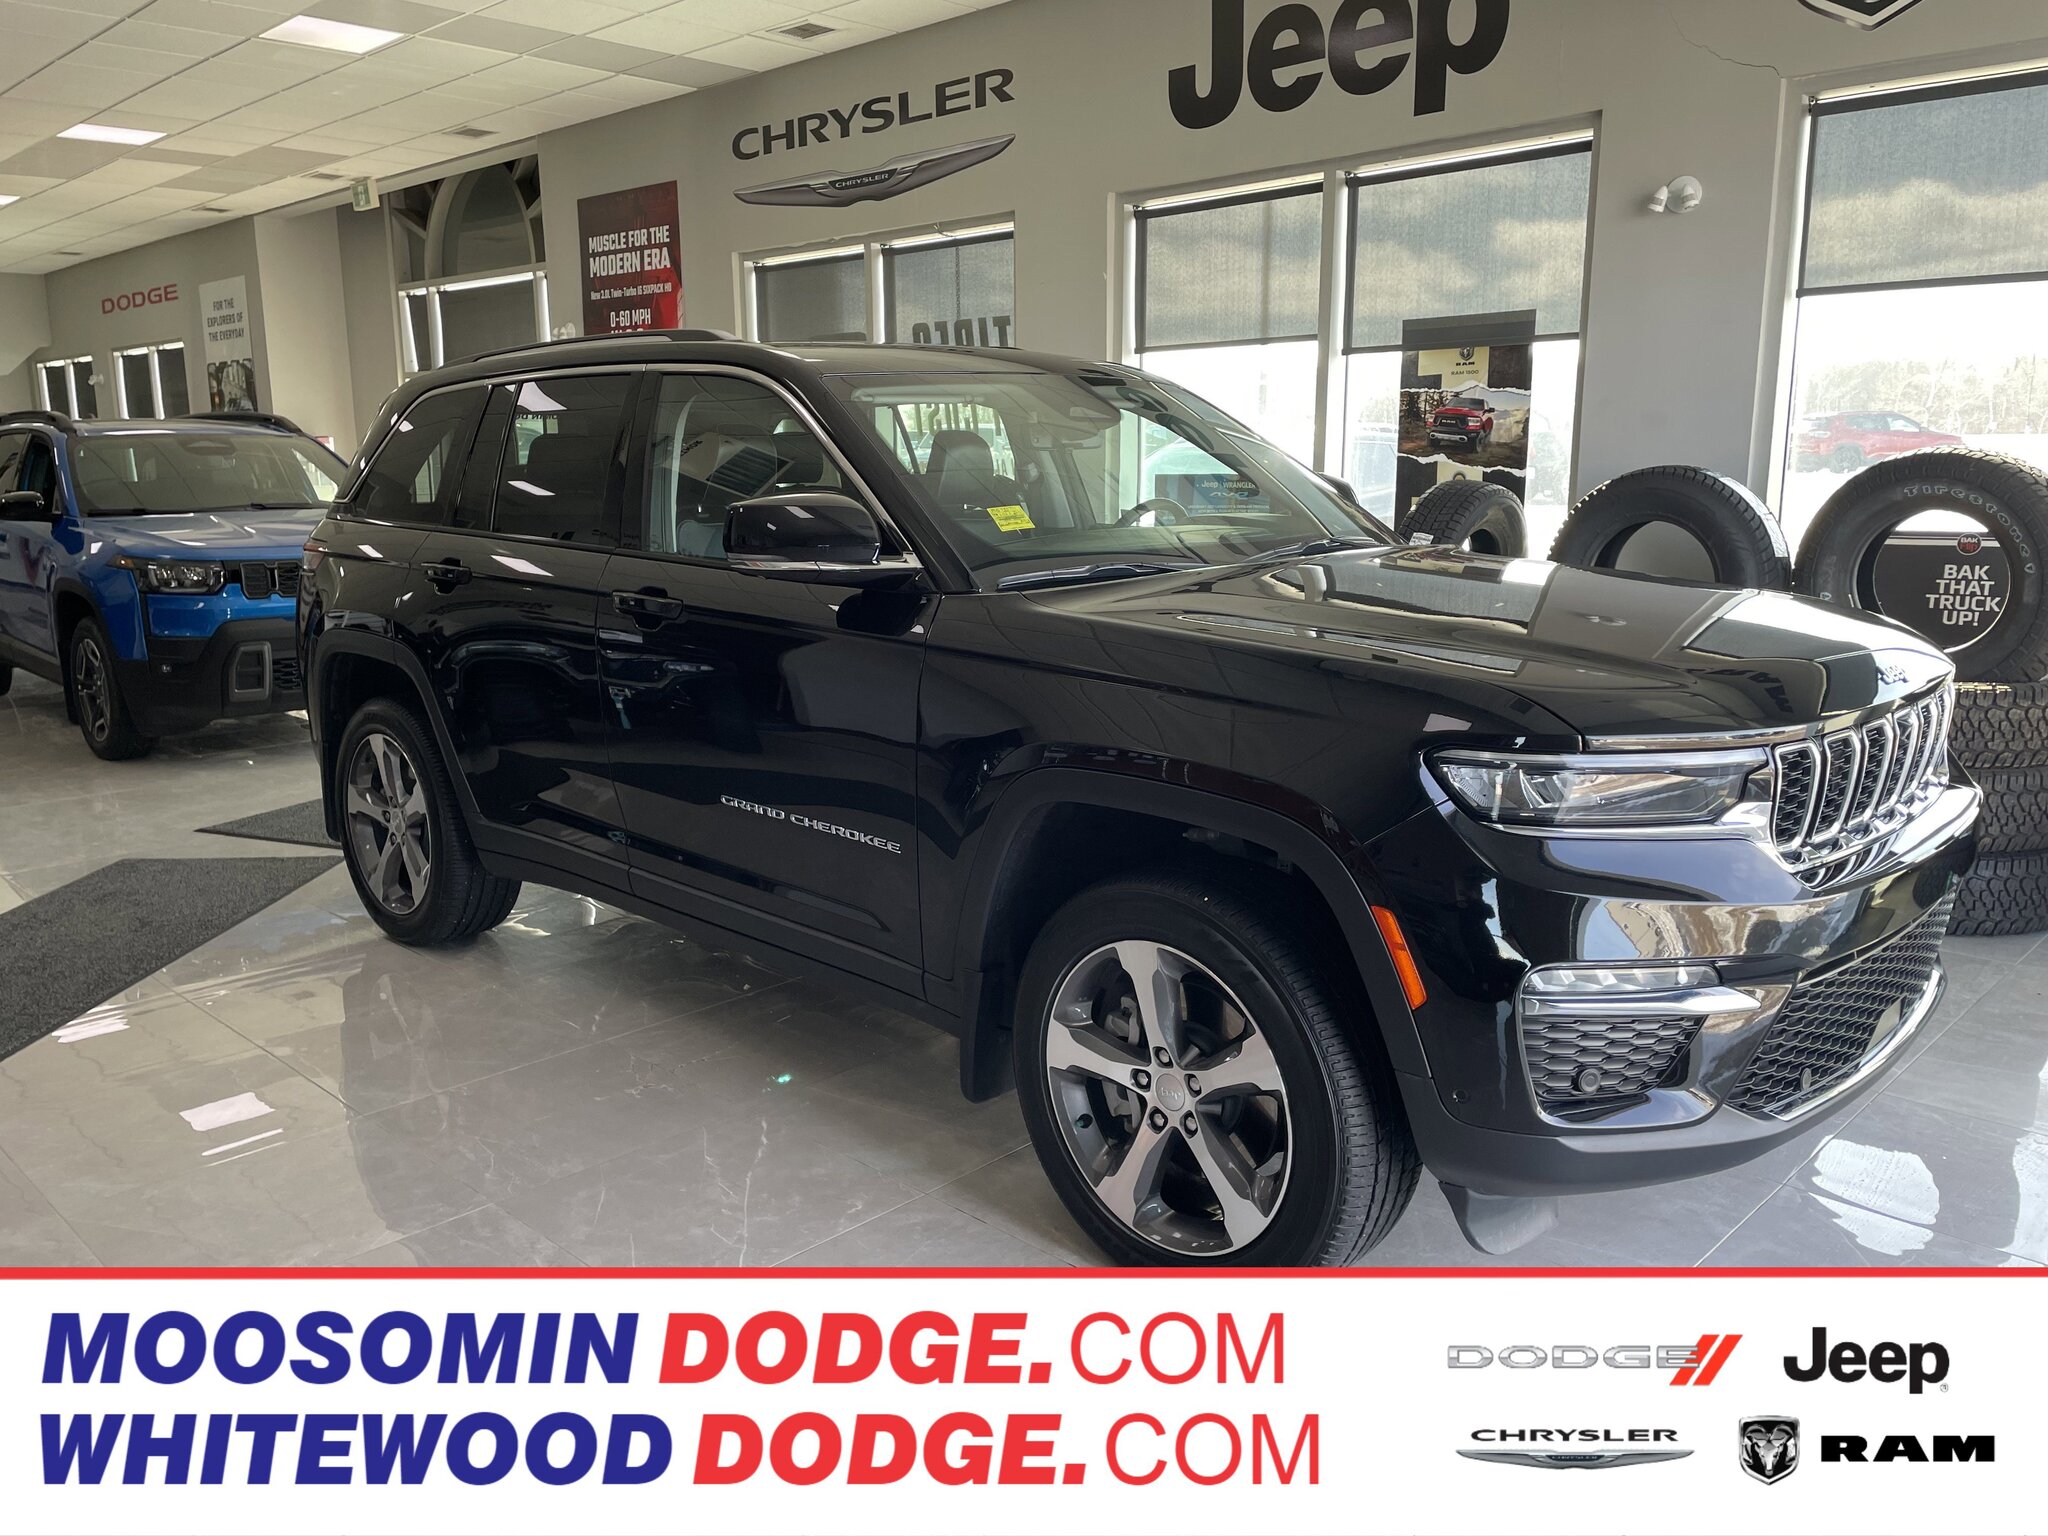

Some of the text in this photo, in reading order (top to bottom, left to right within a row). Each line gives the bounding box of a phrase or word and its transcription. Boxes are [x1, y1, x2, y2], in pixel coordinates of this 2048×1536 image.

[1168, 0, 1510, 129] Jeep
[732, 68, 1015, 160] CHRYSLER
[835, 173, 889, 188] CHRYSLER
[588, 225, 670, 254] MUSCLE FOR THE
[589, 247, 671, 278] MODERN ERA
[102, 284, 179, 315] DODGE
[213, 298, 234, 312] FOR THE
[207, 312, 243, 327] EXPLORERS OF
[610, 308, 651, 328] 0-60 MPH
[208, 328, 245, 342] THE EVERYDAY
[1202, 480, 1218, 488] Jeep
[1943, 564, 1990, 580] BAK
[1936, 579, 1995, 595] THAT
[1926, 594, 2001, 612] TRUCK
[1942, 610, 1980, 626] UP!
[720, 794, 901, 854] GRAND CHEROKEE
